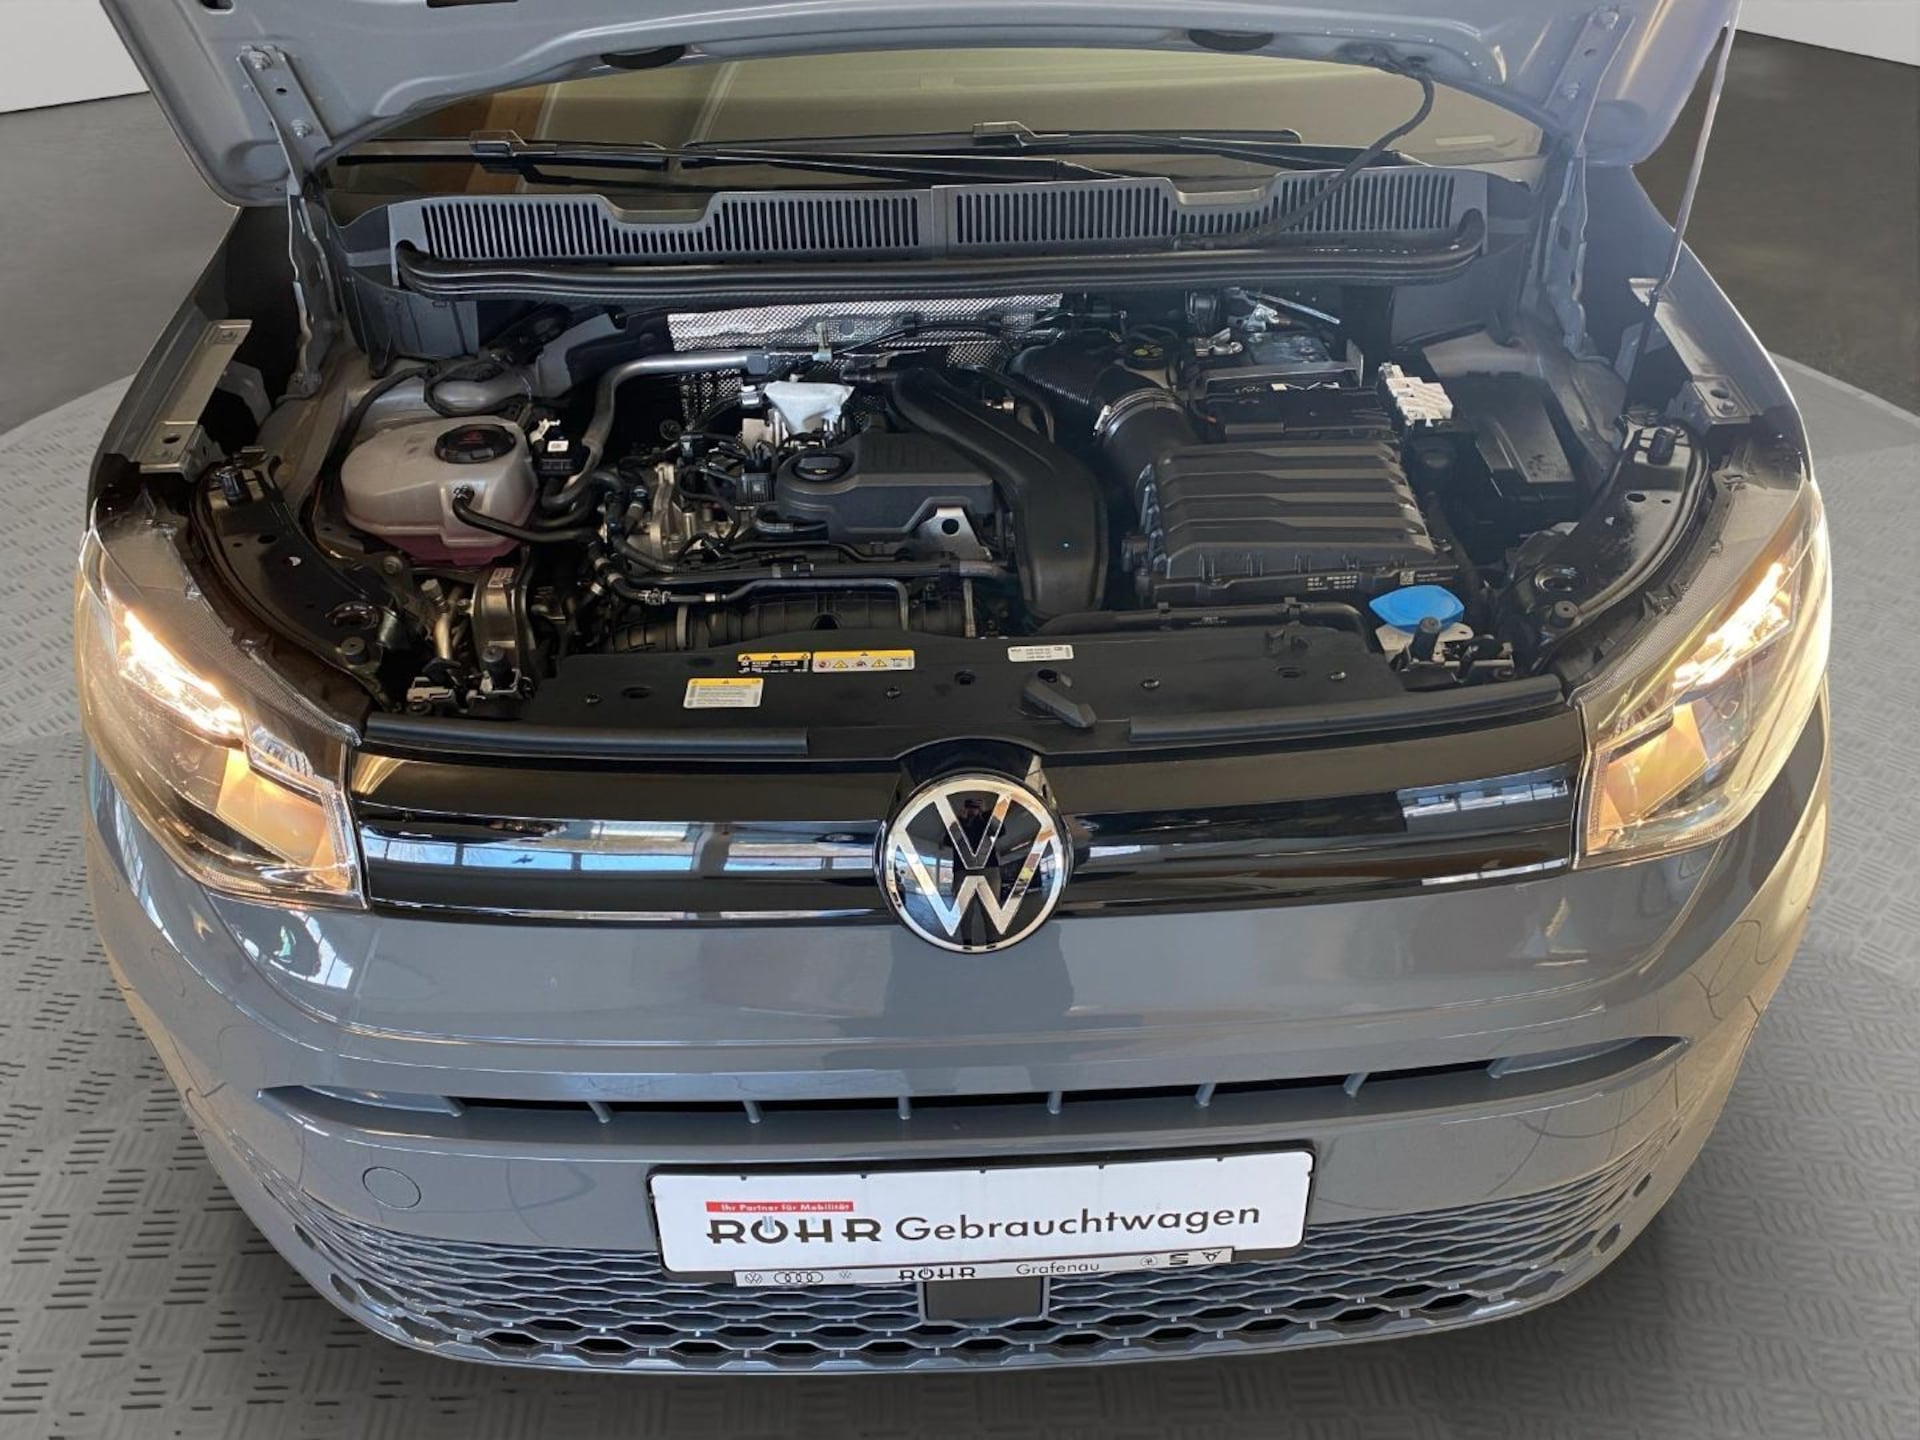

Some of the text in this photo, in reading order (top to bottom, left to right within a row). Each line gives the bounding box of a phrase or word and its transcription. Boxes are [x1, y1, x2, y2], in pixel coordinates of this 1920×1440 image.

[720, 1202, 850, 1212] Ihr Partner für Mobilität
[706, 1207, 1260, 1244] RÖHR Gebrauchtwagen
[898, 1266, 976, 1281] RÖHR
[1016, 1262, 1100, 1276] Grafenau
